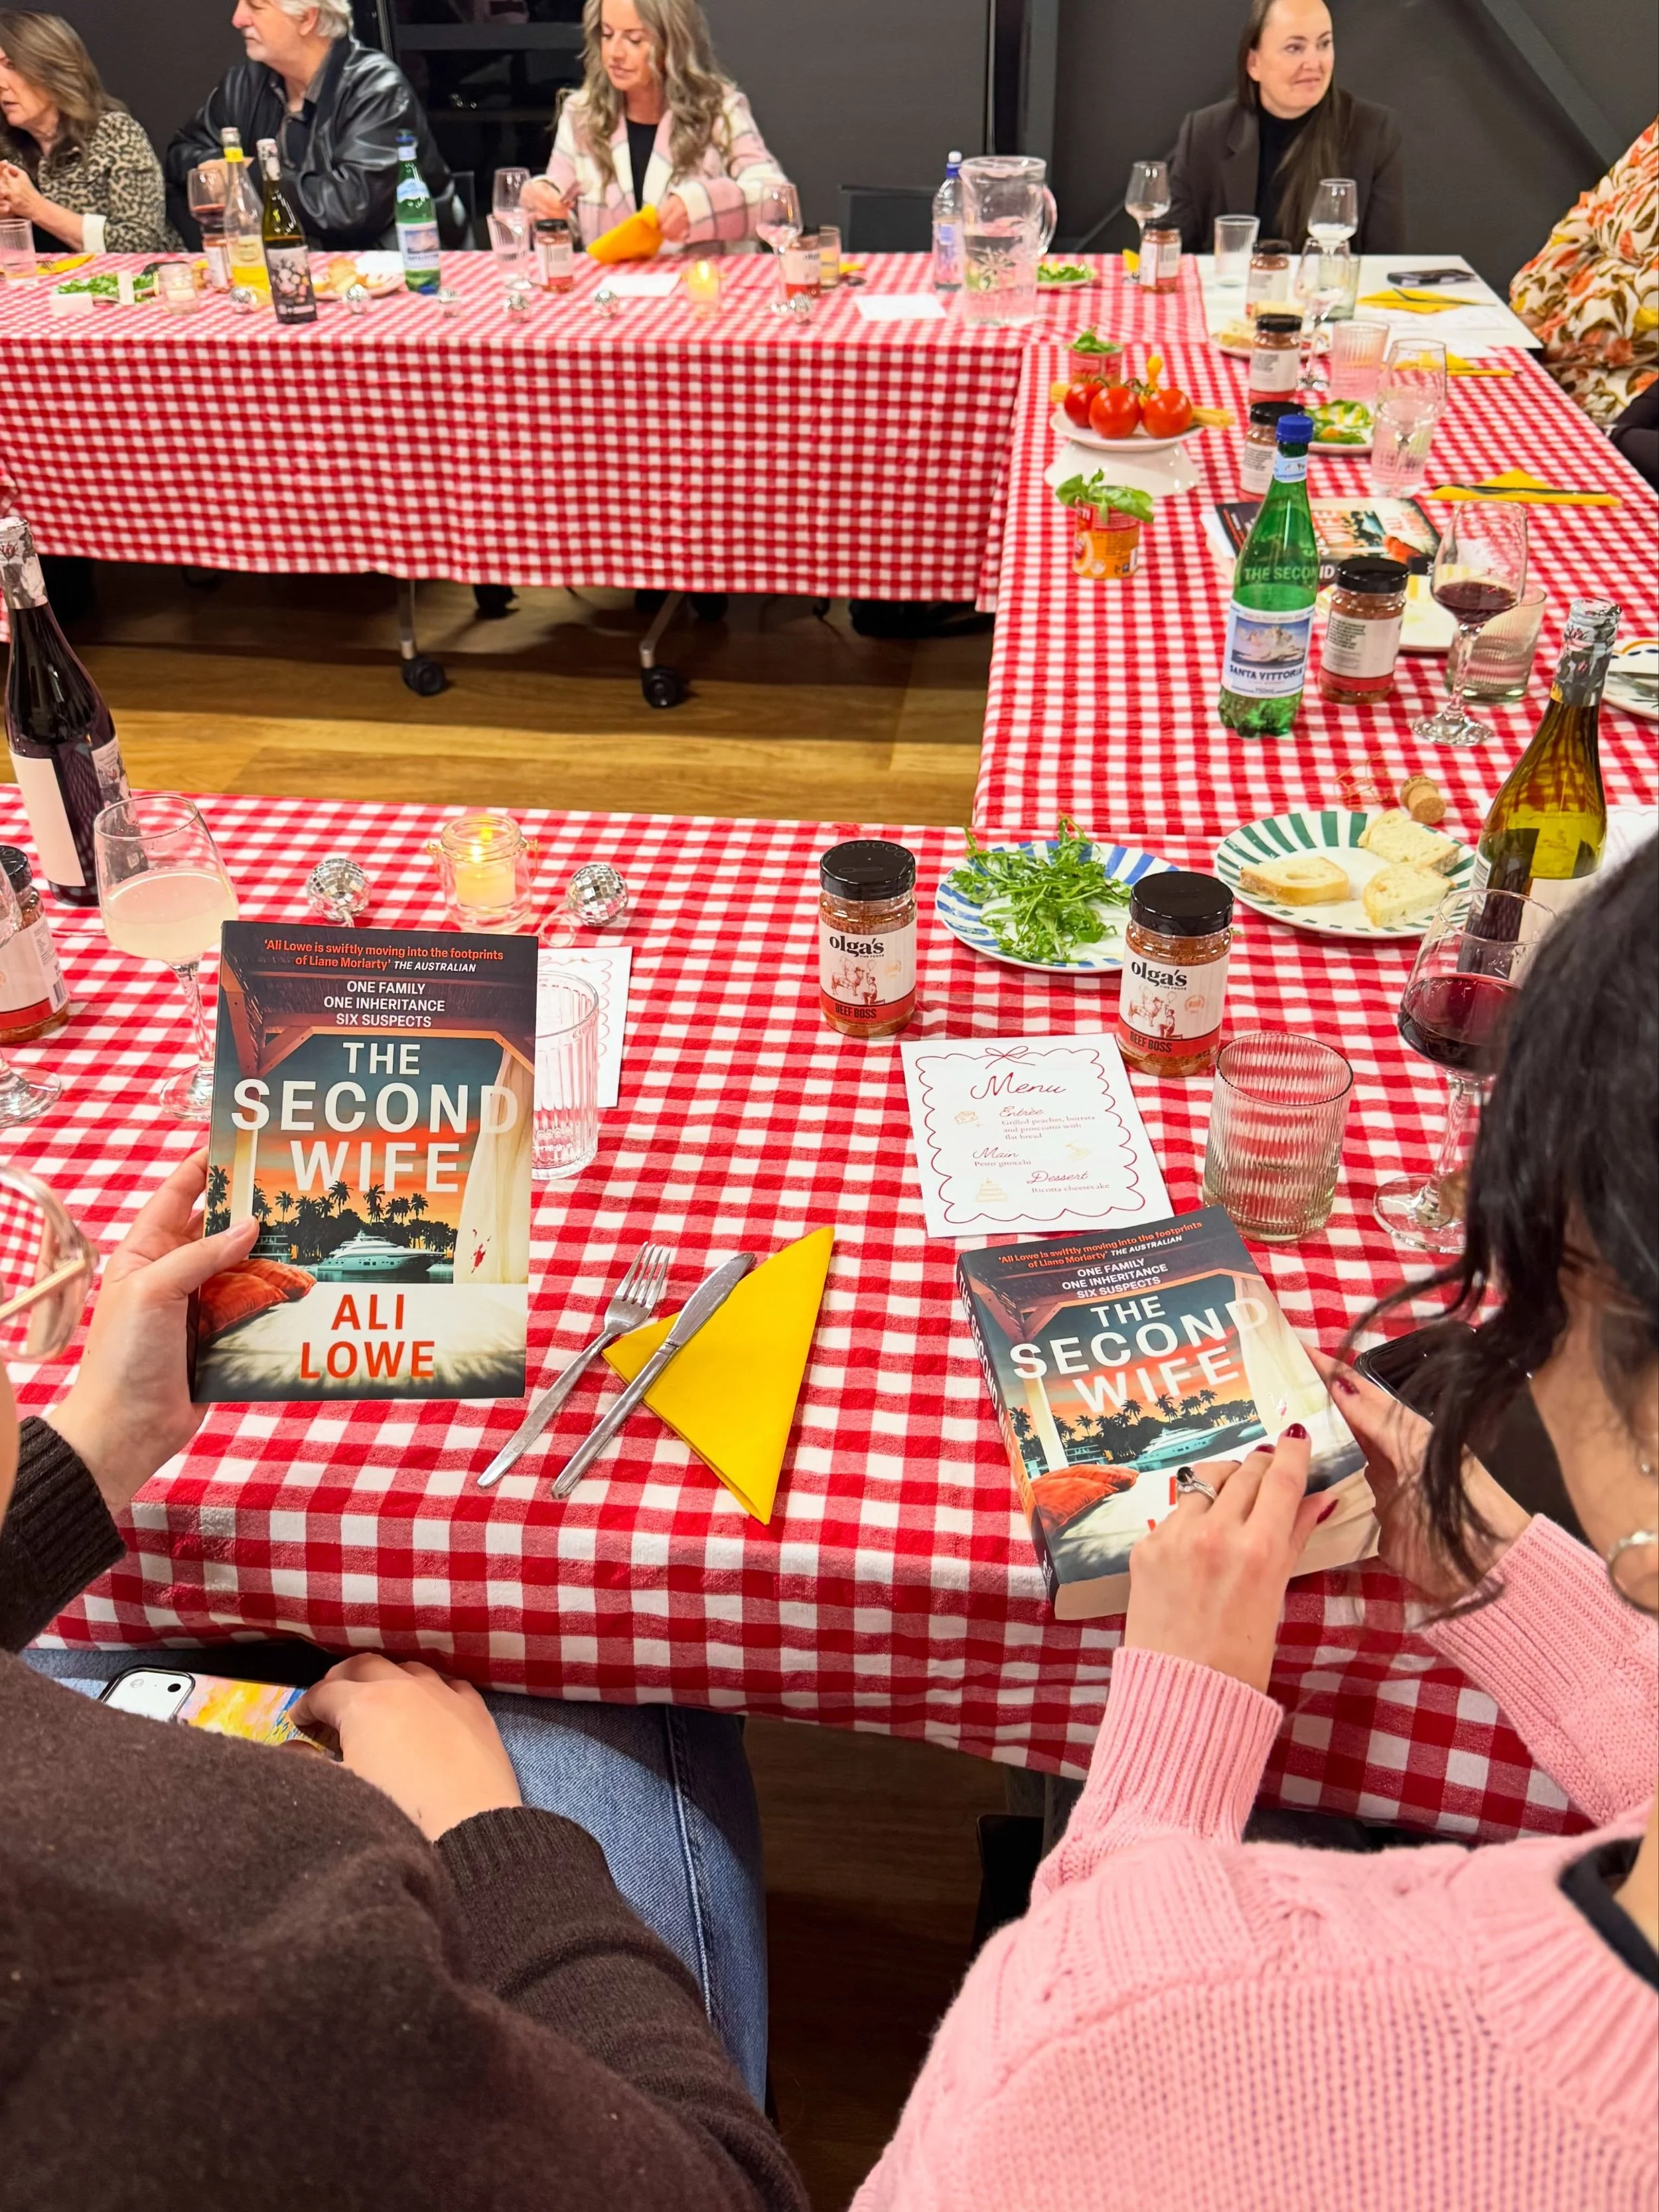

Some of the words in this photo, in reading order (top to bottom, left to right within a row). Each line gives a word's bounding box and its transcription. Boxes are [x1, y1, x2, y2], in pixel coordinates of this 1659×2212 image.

[1245, 567, 1269, 581] THE
[1230, 664, 1256, 679] SANTA
[284, 940, 313, 952] Lowe
[315, 942, 324, 952] is
[326, 943, 364, 956] swiftly
[365, 945, 405, 958] moving
[407, 946, 428, 957] into
[431, 948, 448, 958] the
[450, 948, 504, 961] footprints
[830, 935, 885, 957] olga's
[295, 955, 307, 966] of
[309, 956, 338, 967] Liane
[394, 961, 413, 970] THE
[414, 962, 476, 972] AUSTRALIAN
[1131, 961, 1187, 987] olga's
[346, 980, 376, 994] ONE
[378, 982, 426, 995] FAMILY
[323, 996, 353, 1009] ONE
[356, 997, 445, 1012] INHERITANCE
[835, 1002, 853, 1017] BEEF
[854, 1007, 877, 1019] BOSS
[336, 1013, 359, 1025] SIX
[362, 1014, 432, 1028] SUSPECTS
[1129, 1031, 1147, 1047] BEEF
[1148, 1039, 1173, 1053] BOSS
[342, 1042, 420, 1074] THE
[970, 1072, 1066, 1100] Menu
[231, 1078, 518, 1134] SECOND
[973, 1147, 1019, 1159] Main
[290, 1140, 460, 1192] WIFE
[1027, 1170, 1088, 1184] Dessert
[1028, 1260, 1040, 1269] of
[1110, 1247, 1127, 1257] THE
[1129, 1234, 1183, 1254] AUSTRALIAN
[1050, 1246, 1082, 1258] swiftly
[1082, 1241, 1118, 1253] moving
[1118, 1237, 1137, 1247] into
[1138, 1232, 1155, 1242] the
[1155, 1221, 1202, 1240] footprints
[1062, 1279, 1088, 1291] ONE
[1088, 1264, 1168, 1288] INHERITANCE
[1077, 1267, 1103, 1278] ONE
[1105, 1258, 1145, 1274] FAMILY
[1076, 1289, 1096, 1299] SIX
[1098, 1276, 1161, 1295] SUSPECTS
[330, 1293, 405, 1331] ALI
[1090, 1296, 1165, 1327] THE
[959, 1270, 972, 1315] THE
[970, 1314, 997, 1411] SECOND
[1010, 1297, 1269, 1379] SECOND
[299, 1340, 435, 1379] LOWE
[1072, 1346, 1240, 1413] WIFE
